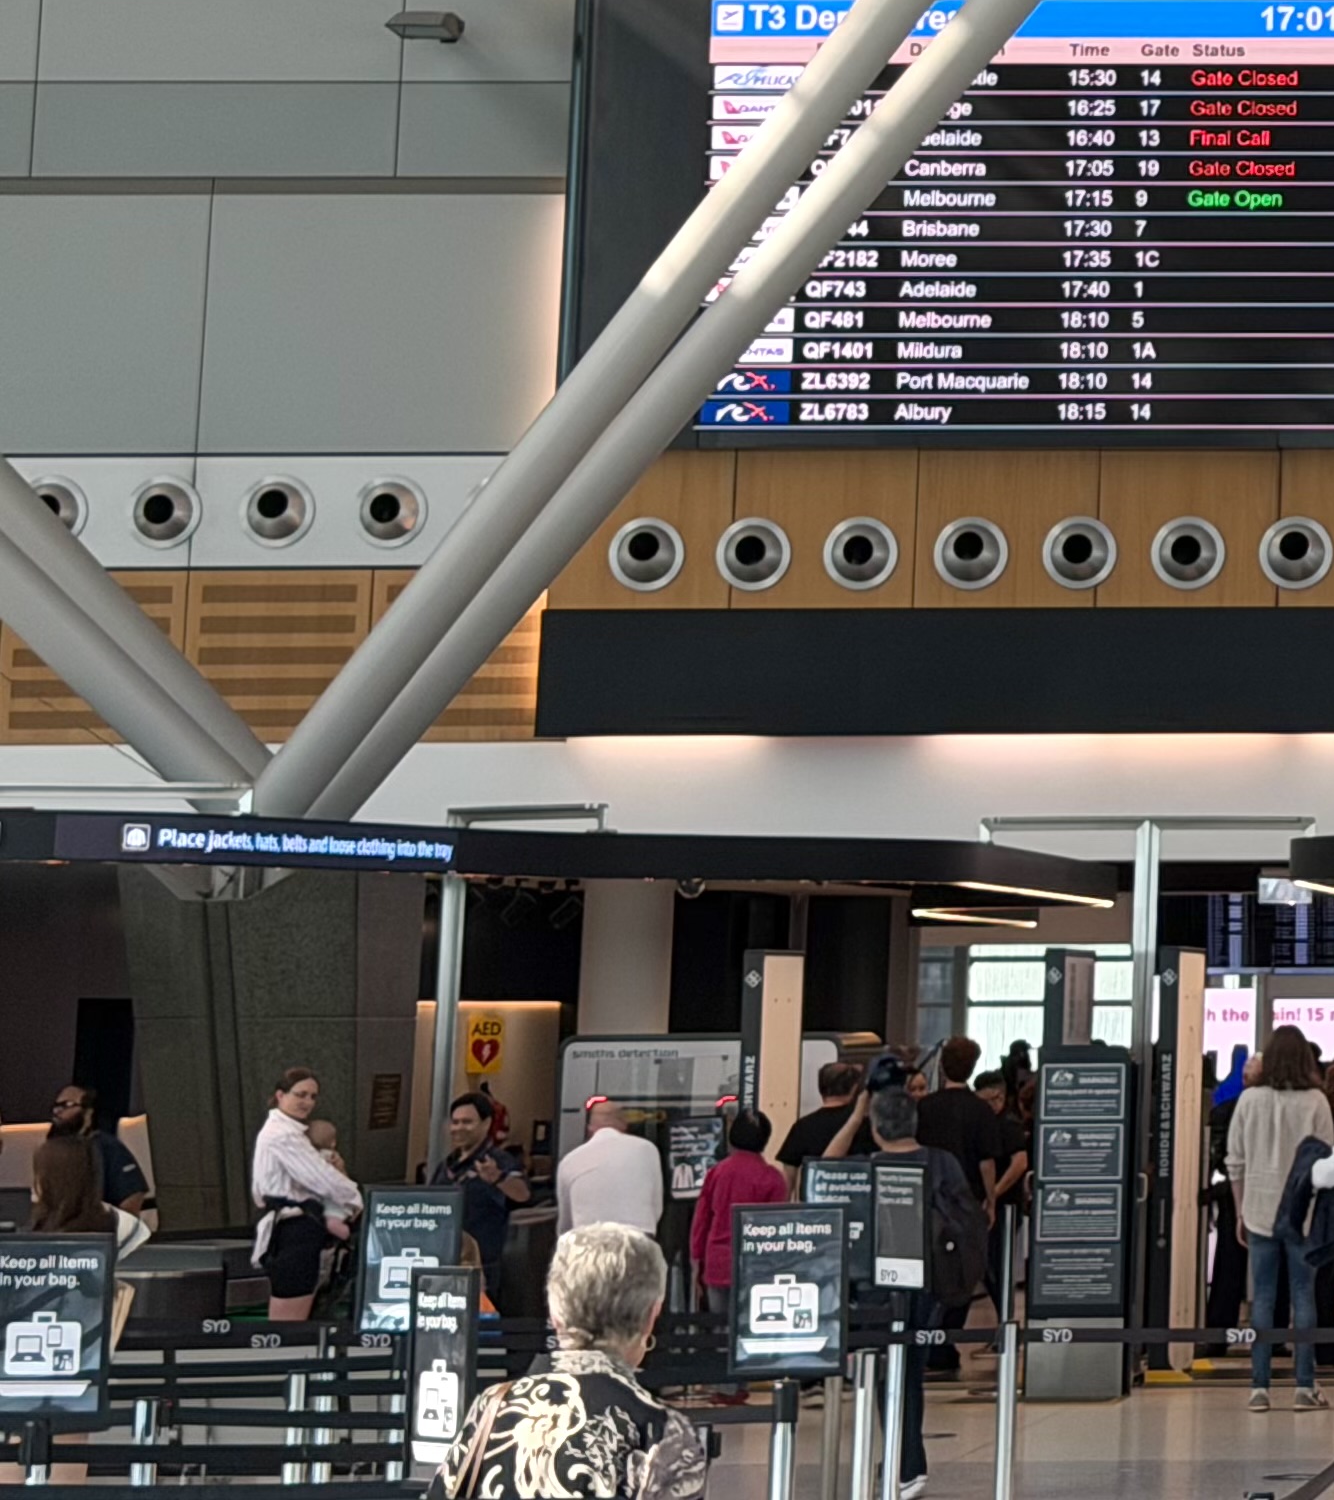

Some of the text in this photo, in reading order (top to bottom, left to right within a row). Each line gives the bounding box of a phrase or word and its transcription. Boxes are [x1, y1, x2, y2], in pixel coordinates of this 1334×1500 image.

[748, 4, 786, 30] T3
[1070, 44, 1245, 57] Time Gate Status
[1068, 69, 1298, 87] 15:30 14 Gate Closed
[1067, 99, 1297, 116] 16:25 17 Gate Closed
[1067, 130, 1270, 147] 16:40 13 Final Call
[904, 160, 1295, 177] Canberra 17:05 19 Gate Closed
[903, 190, 1282, 209] Melbourne 17:15 9 Gate Open
[902, 220, 1147, 237] Brisbane 17:30 7
[901, 251, 1160, 267] Moree 17:35 1C
[805, 281, 1143, 298] QF743 Adelaide 17:40 1
[804, 312, 1144, 328] QF481 Melbourne 18:10 5
[803, 342, 1156, 359] QF1401 Mildura 18:10 1A
[801, 373, 1152, 392] ZL6392 Port Macquarie 18:10 14
[800, 404, 1150, 424] ZL6783 Albury 18:15 14
[158, 829, 204, 848] Place
[472, 1022, 501, 1036] AED
[743, 1223, 832, 1238] Keep all items
[743, 1240, 816, 1254] in your bag.
[0, 1255, 98, 1271] Keep all items
[0, 1273, 80, 1289] in your bag.
[916, 1329, 946, 1346] SYD
[1042, 1327, 1073, 1344] SYD
[1226, 1327, 1257, 1344] SYD
